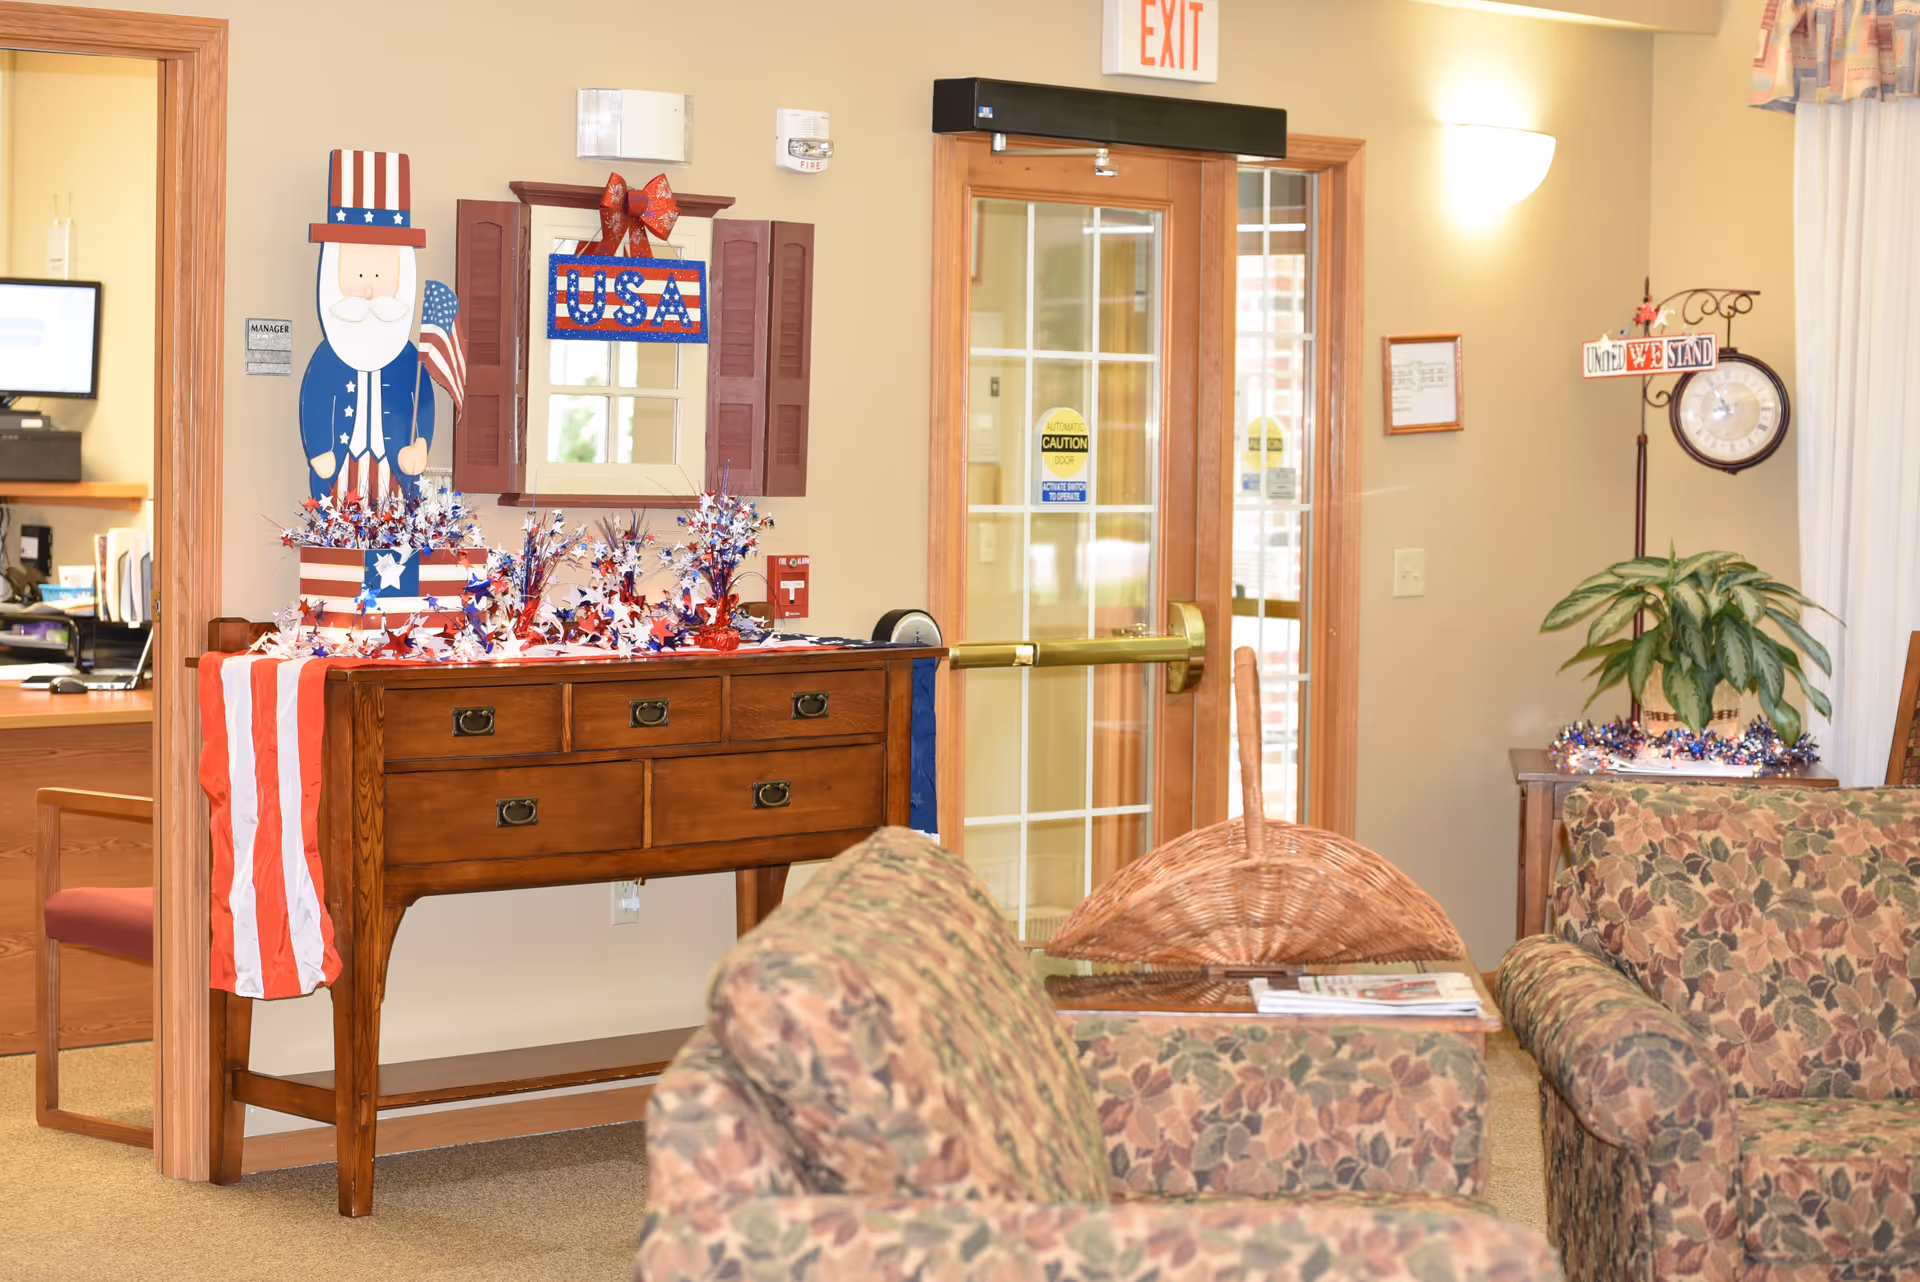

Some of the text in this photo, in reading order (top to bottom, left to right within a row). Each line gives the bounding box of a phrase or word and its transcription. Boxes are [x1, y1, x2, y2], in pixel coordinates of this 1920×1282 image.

[1140, 0, 1204, 71] EXIT
[800, 161, 821, 170] FIRE
[566, 269, 693, 328] USA
[250, 324, 290, 334] MANAGER
[1628, 341, 1664, 369] WE
[1667, 339, 1712, 367] STAND
[1046, 422, 1085, 432] AUTOMATIC
[1042, 436, 1087, 449] CAUTION
[1055, 455, 1075, 465] DOOR
[1043, 482, 1067, 491] ACTIVATE
[1049, 492, 1081, 501] TO OPERATE
